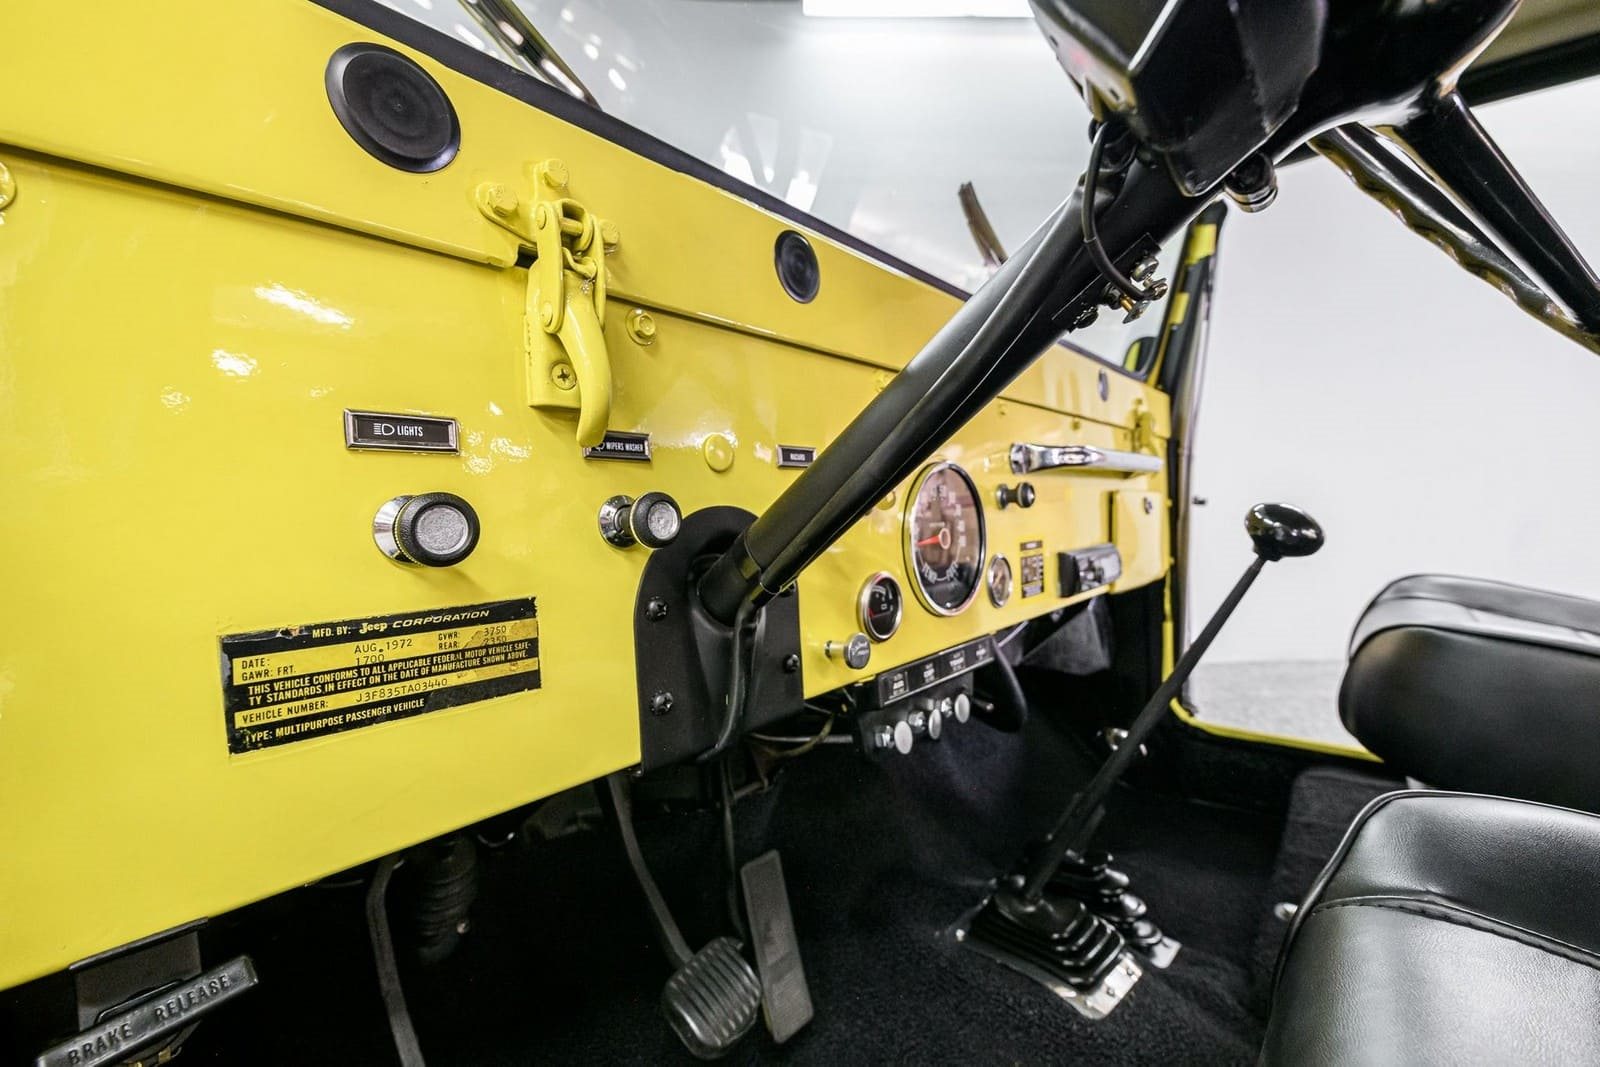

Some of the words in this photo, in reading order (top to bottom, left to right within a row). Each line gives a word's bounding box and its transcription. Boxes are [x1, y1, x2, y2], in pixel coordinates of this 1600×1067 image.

[397, 425, 423, 437] LIGHTS
[606, 441, 624, 451] WIPERS
[625, 443, 643, 452] WASHER
[312, 627, 334, 639] MFD.
[336, 625, 352, 636] BY:
[359, 622, 388, 634] Jeep
[392, 610, 490, 628] CORPORATION
[484, 625, 507, 637] 3750
[354, 643, 385, 654] AUG.
[386, 639, 413, 650] 1972
[438, 641, 461, 650] REAR:
[241, 658, 270, 669] DATE:
[356, 654, 385, 666] 1700
[241, 669, 273, 681] GAWR:
[277, 665, 297, 675] FRT.
[248, 685, 271, 696] THIS
[273, 676, 311, 692] VEHICLE
[313, 667, 358, 685] CONFORMS
[360, 665, 371, 676] TO
[372, 664, 386, 674] ALL
[388, 655, 432, 672] APPLICABLE
[488, 643, 513, 656] VEHICLE
[248, 695, 261, 706] TY
[266, 686, 322, 703] STANDARDS
[325, 683, 335, 693] IN
[337, 677, 367, 690] EFFECT
[369, 674, 381, 684] ON
[383, 671, 399, 682] THE
[400, 669, 419, 680] DATE
[420, 666, 431, 675] OF
[431, 657, 481, 674] MANUFACTURE
[482, 654, 505, 664] SHOWN
[242, 708, 283, 724] VEHICLE
[287, 700, 329, 715] NUMBER:
[275, 715, 344, 738] MULTIPURPOSE
[346, 705, 392, 723] PASSENGER
[393, 698, 425, 713] VEHICLE
[67, 1022, 133, 1067] BRAKE
[154, 973, 232, 1022] RELEASE
